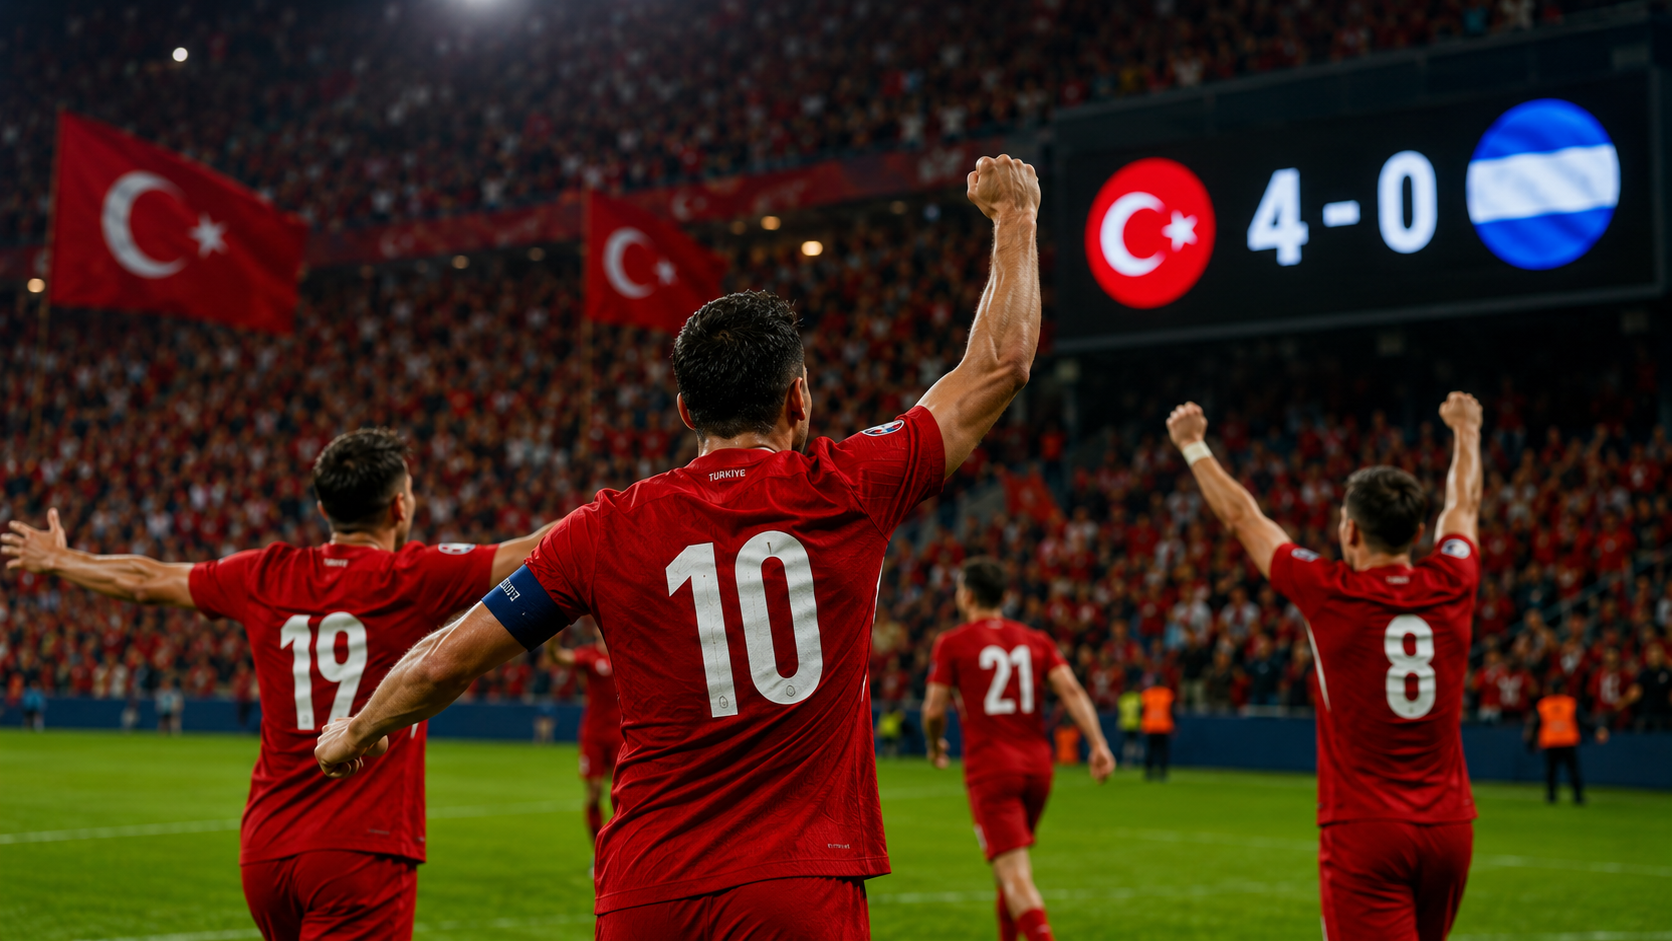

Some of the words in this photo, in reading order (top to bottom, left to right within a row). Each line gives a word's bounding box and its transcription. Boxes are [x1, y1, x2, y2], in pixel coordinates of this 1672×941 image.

[280, 611, 368, 731] 19
[665, 530, 824, 718] 10
[978, 644, 1035, 716] 21
[1383, 614, 1436, 720] 8
